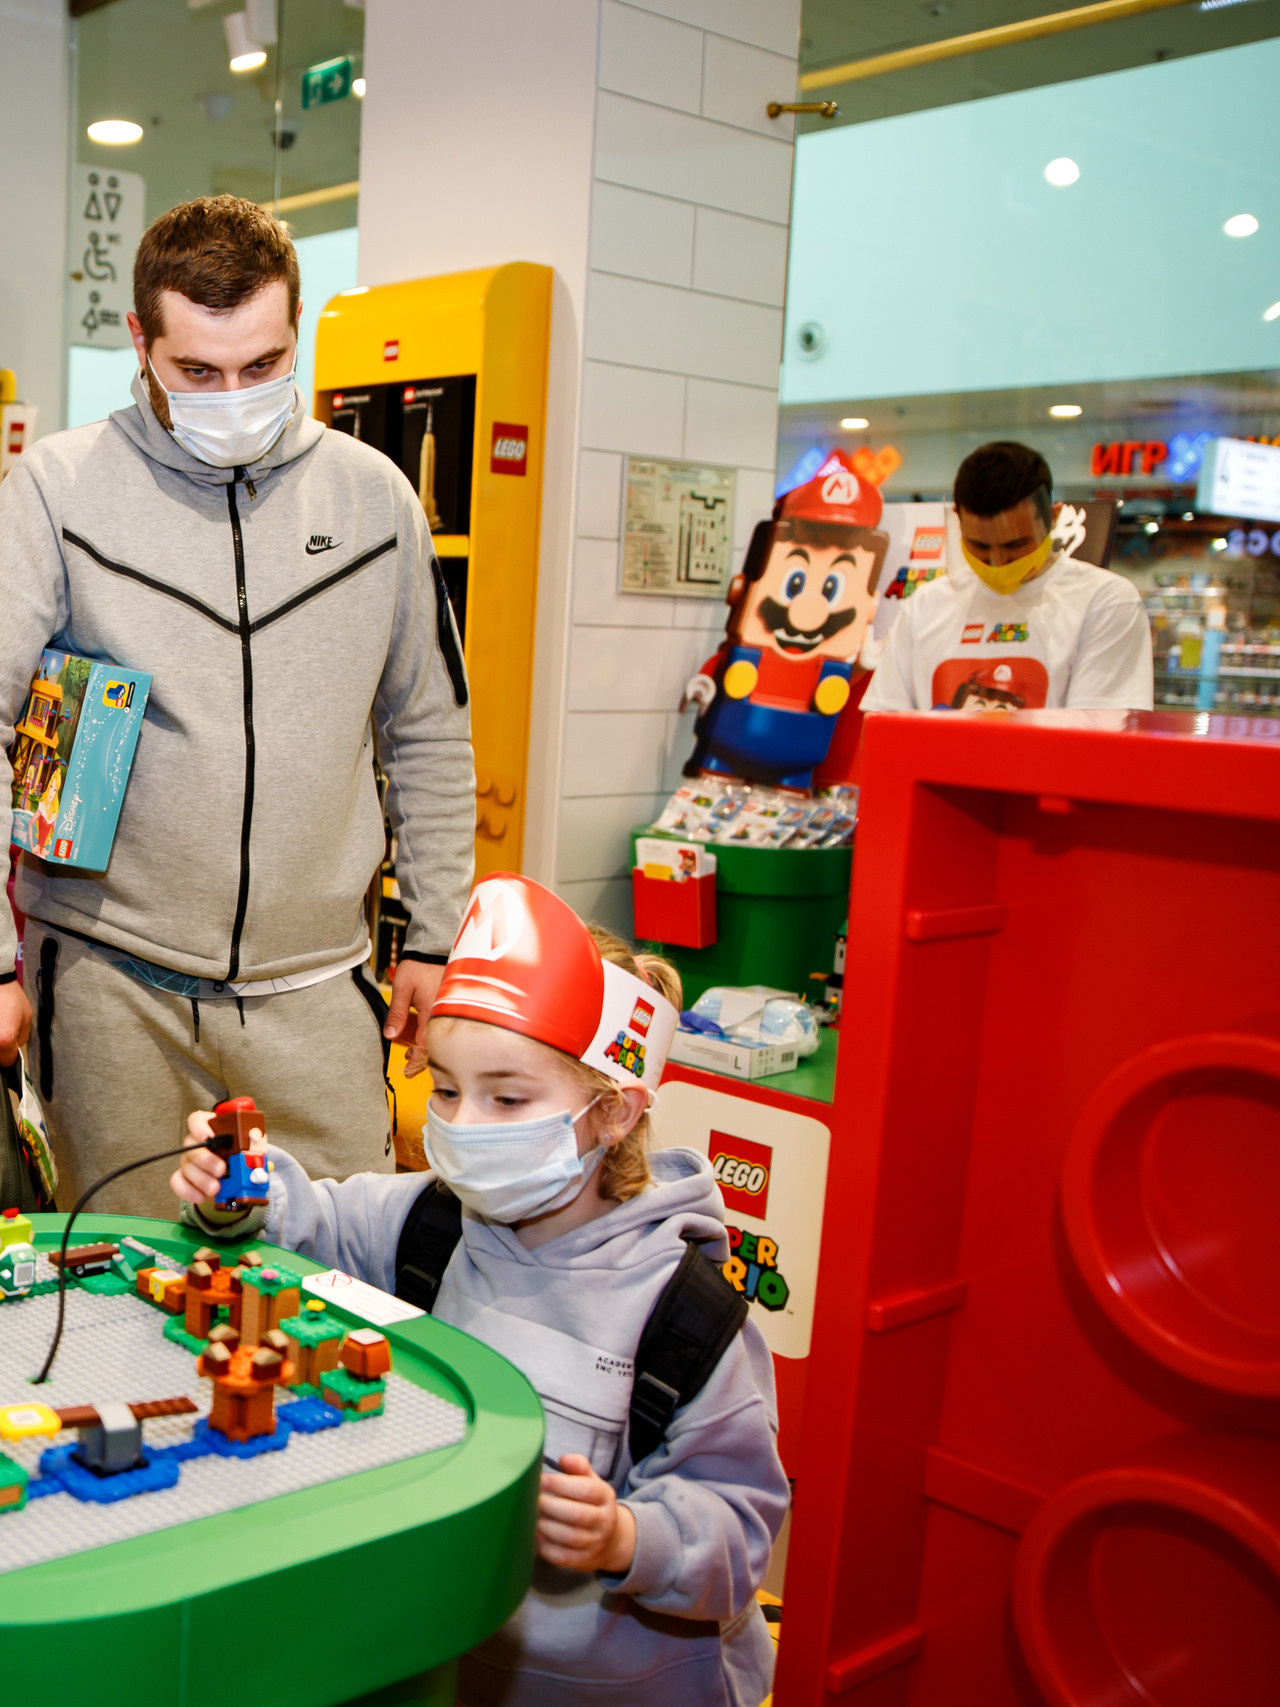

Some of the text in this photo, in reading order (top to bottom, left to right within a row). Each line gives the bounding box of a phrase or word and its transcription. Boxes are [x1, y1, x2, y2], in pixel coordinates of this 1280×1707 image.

[493, 438, 526, 460] LEGO
[309, 535, 333, 547] NIKE
[913, 534, 945, 551] LEGO
[57, 839, 70, 858] LEGO
[631, 1007, 653, 1028] LEGO
[616, 1030, 647, 1059] SUPER
[604, 1041, 645, 1078] MARIO
[713, 1154, 769, 1194] LEGO
[725, 1225, 779, 1270] PER
[722, 1255, 790, 1312] RIO
